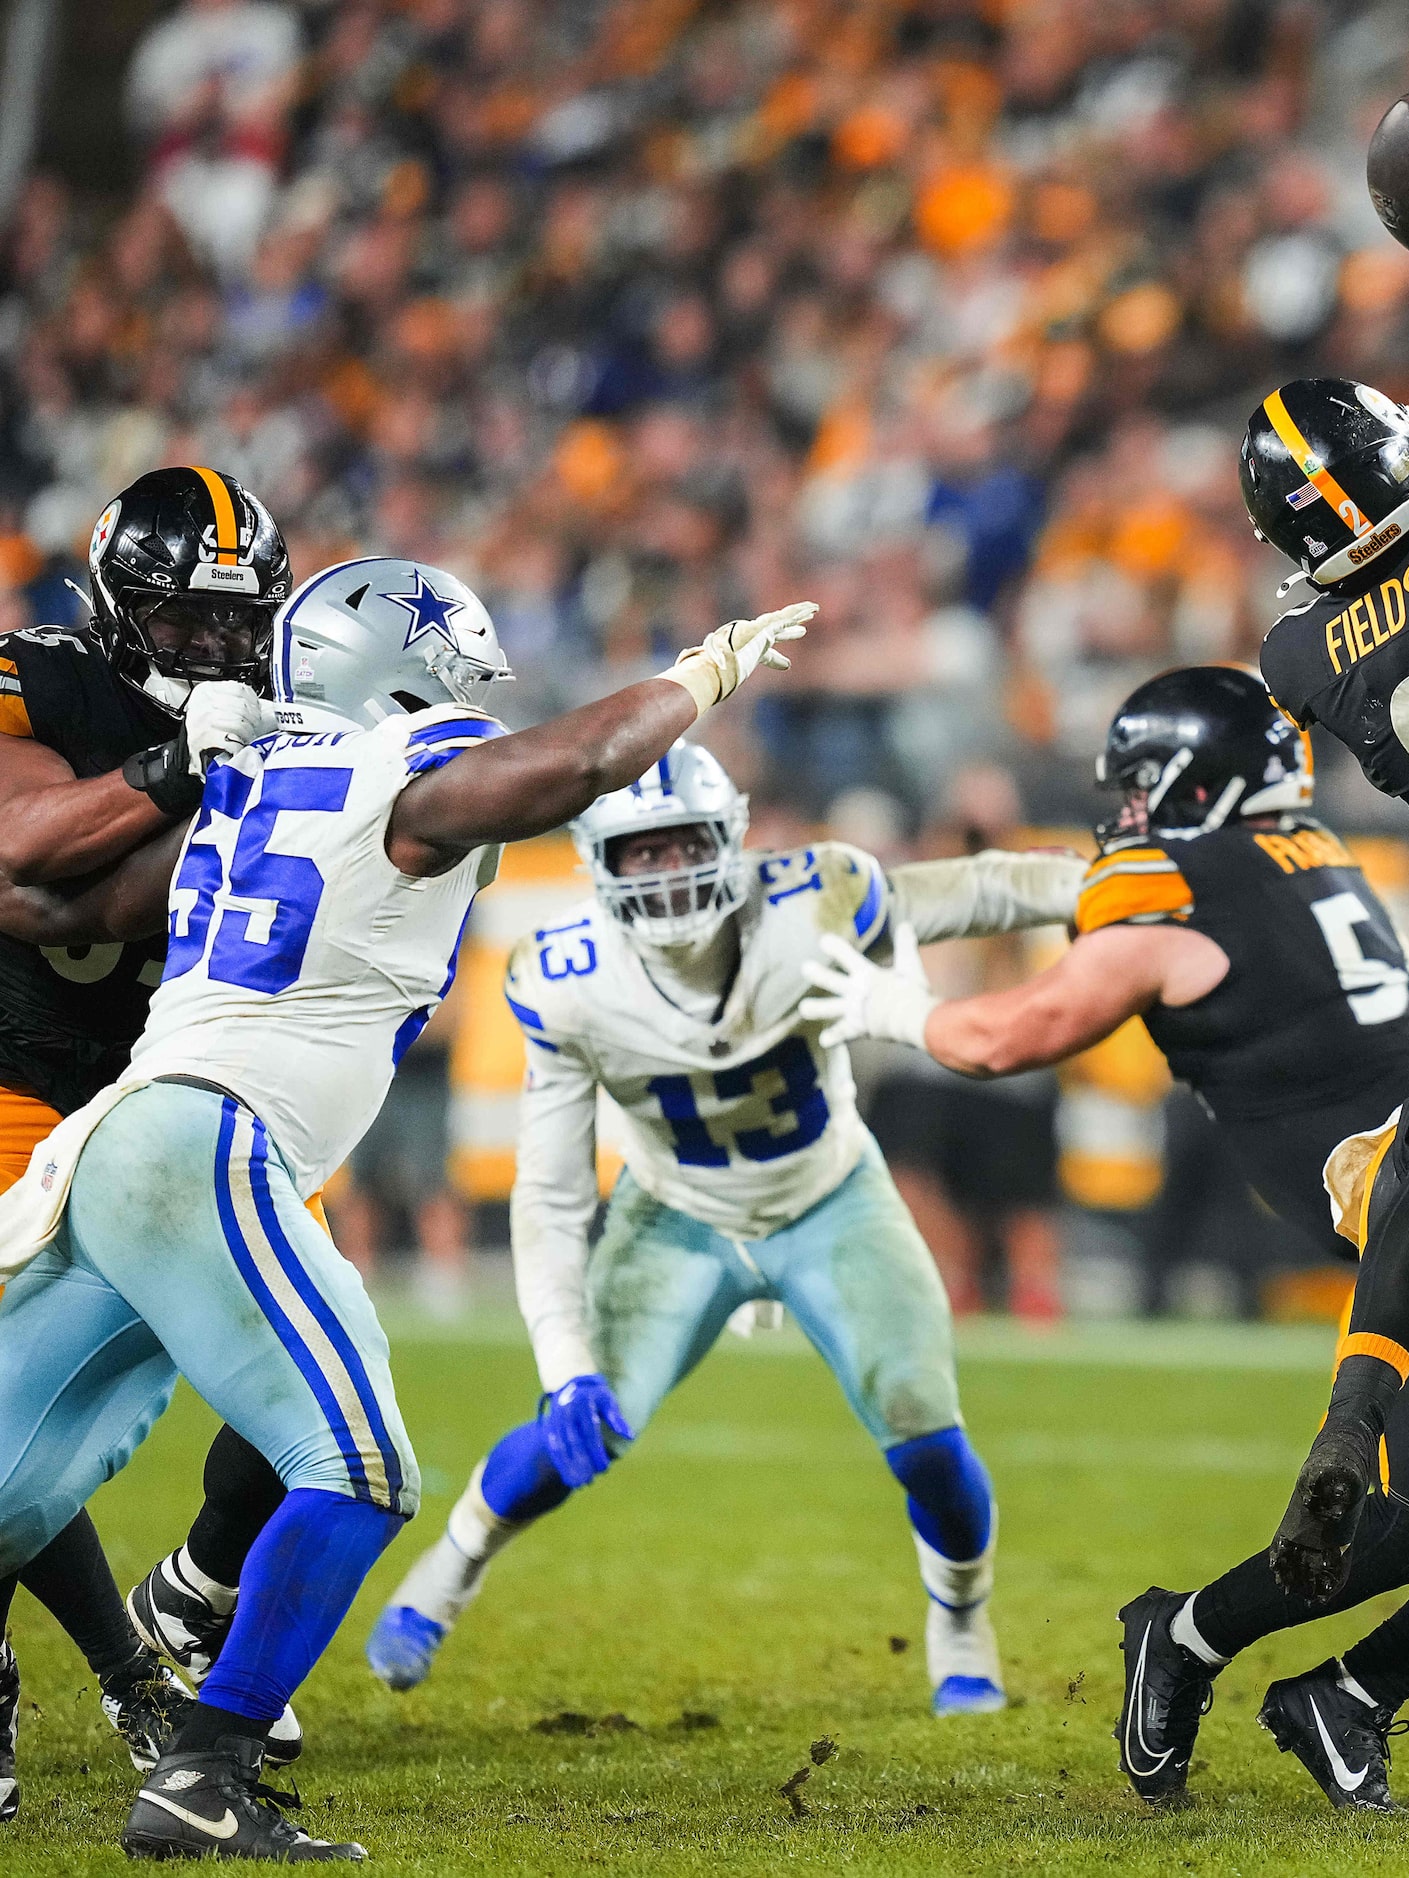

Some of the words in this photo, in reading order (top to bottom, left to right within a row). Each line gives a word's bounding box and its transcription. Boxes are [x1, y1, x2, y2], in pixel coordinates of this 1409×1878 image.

[1339, 500, 1371, 538] 2
[1348, 523, 1401, 565] Steelers
[211, 569, 244, 581] Steelers
[275, 711, 304, 725] BOYS
[536, 917, 598, 981] 13
[646, 1036, 831, 1168] 13
